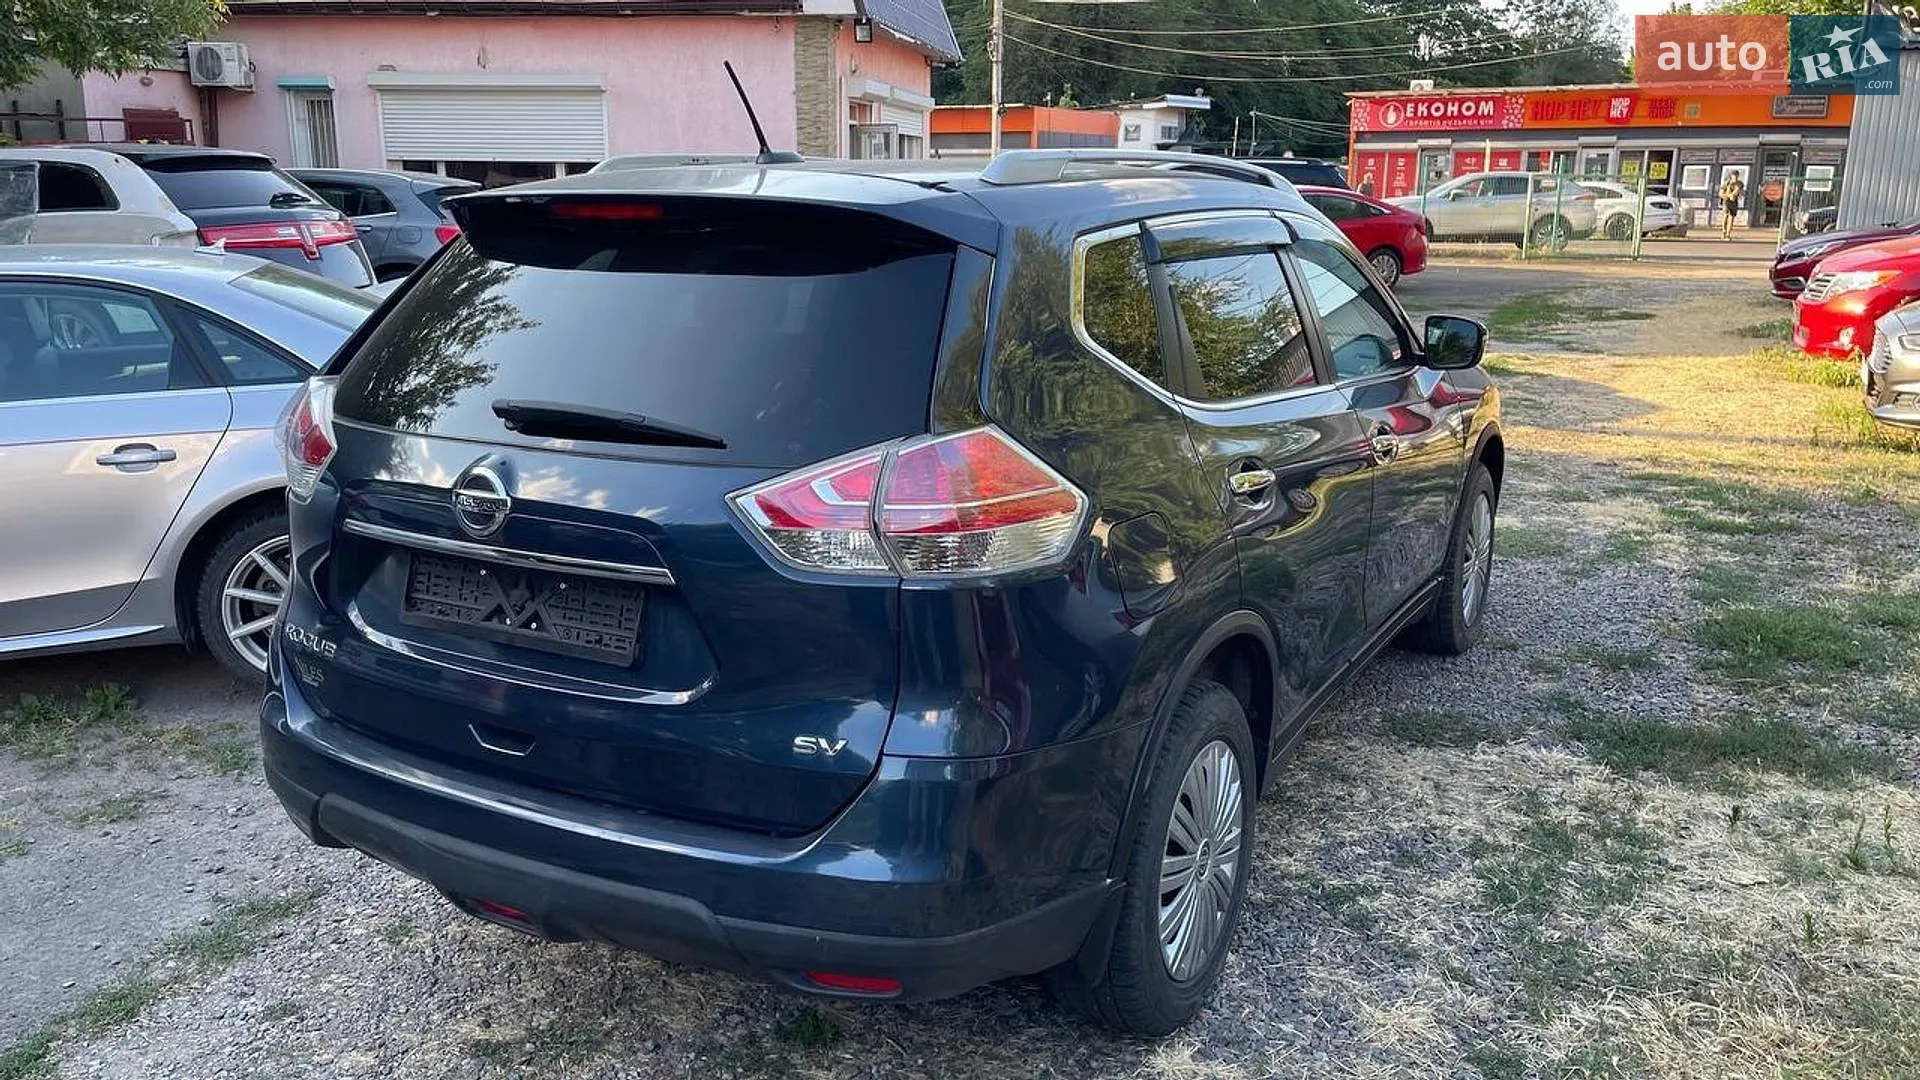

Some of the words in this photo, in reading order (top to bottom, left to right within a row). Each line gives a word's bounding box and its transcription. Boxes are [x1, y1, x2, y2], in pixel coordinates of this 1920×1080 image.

[1405, 100, 1494, 118] ЕКОНОМ
[286, 622, 337, 658] ROGUE
[793, 736, 847, 756] SV
